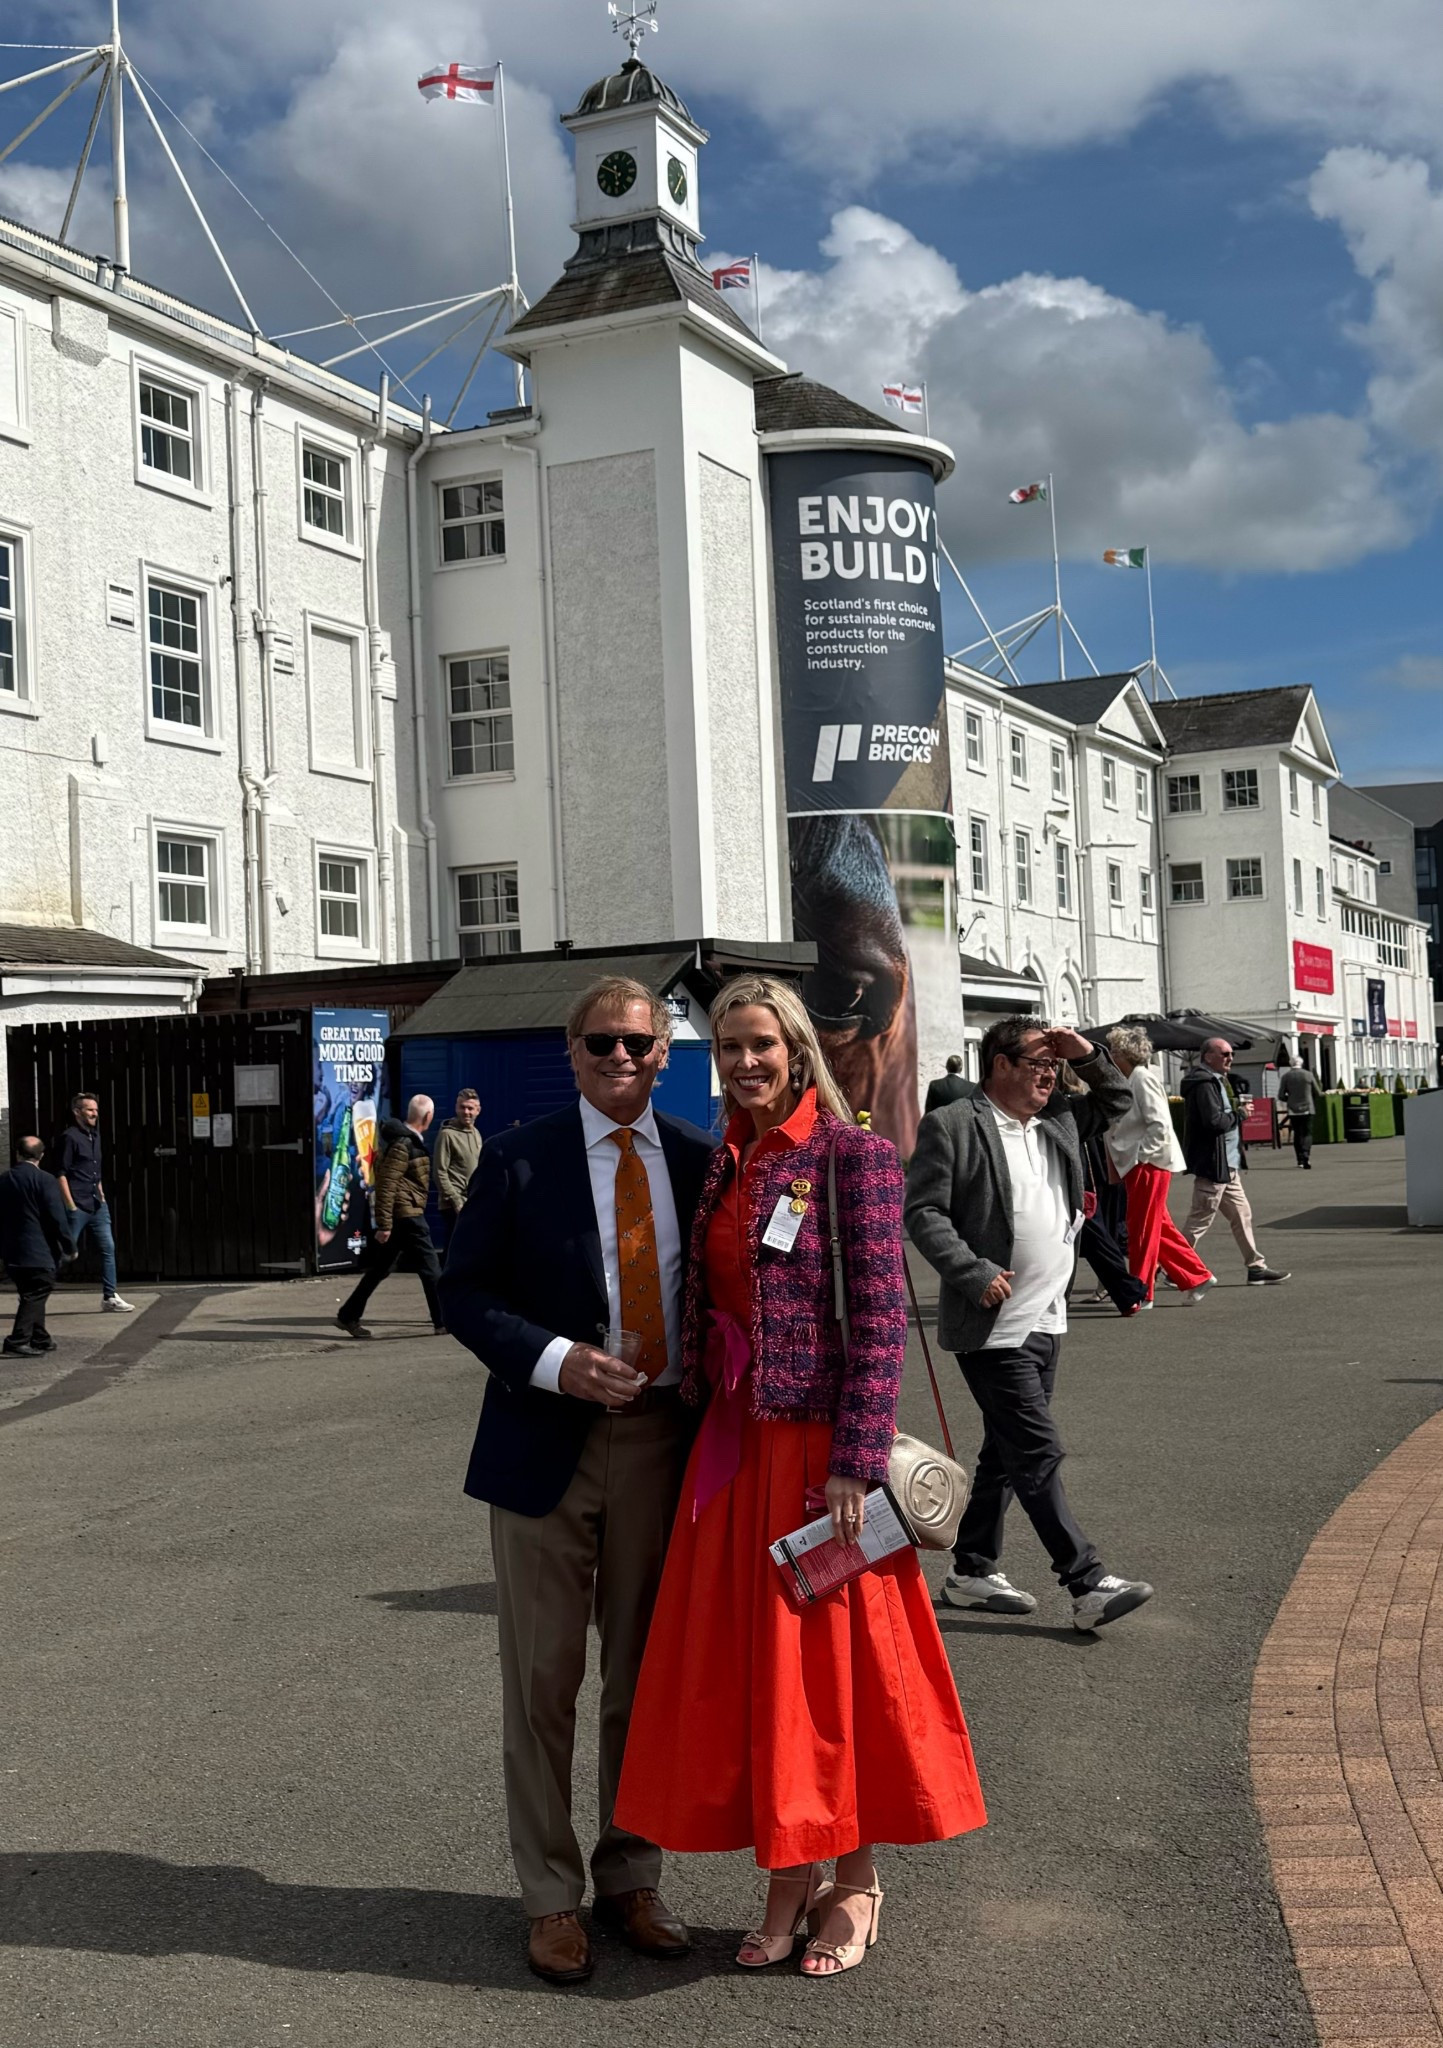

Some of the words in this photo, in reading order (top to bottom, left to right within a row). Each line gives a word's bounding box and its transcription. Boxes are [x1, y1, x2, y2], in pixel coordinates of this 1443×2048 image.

[798, 496, 931, 542] ENJOY
[800, 541, 927, 585] BUILD
[804, 598, 871, 611] Scotland's
[873, 599, 896, 611] first
[898, 602, 928, 615] choice
[805, 614, 825, 626] for
[828, 614, 896, 626] sustainable
[899, 617, 936, 632] concrete
[806, 628, 865, 642] products
[867, 628, 886, 640] for
[888, 630, 906, 641] the
[807, 643, 888, 655] construction
[807, 657, 866, 671] industry.
[871, 725, 940, 747] PRECON
[868, 744, 932, 764] BRICKS
[320, 1026, 351, 1042] GREAT
[352, 1027, 384, 1043] TASTE,
[318, 1043, 355, 1062] MORE
[355, 1043, 386, 1062] GOOD
[333, 1064, 374, 1083] TIMES
